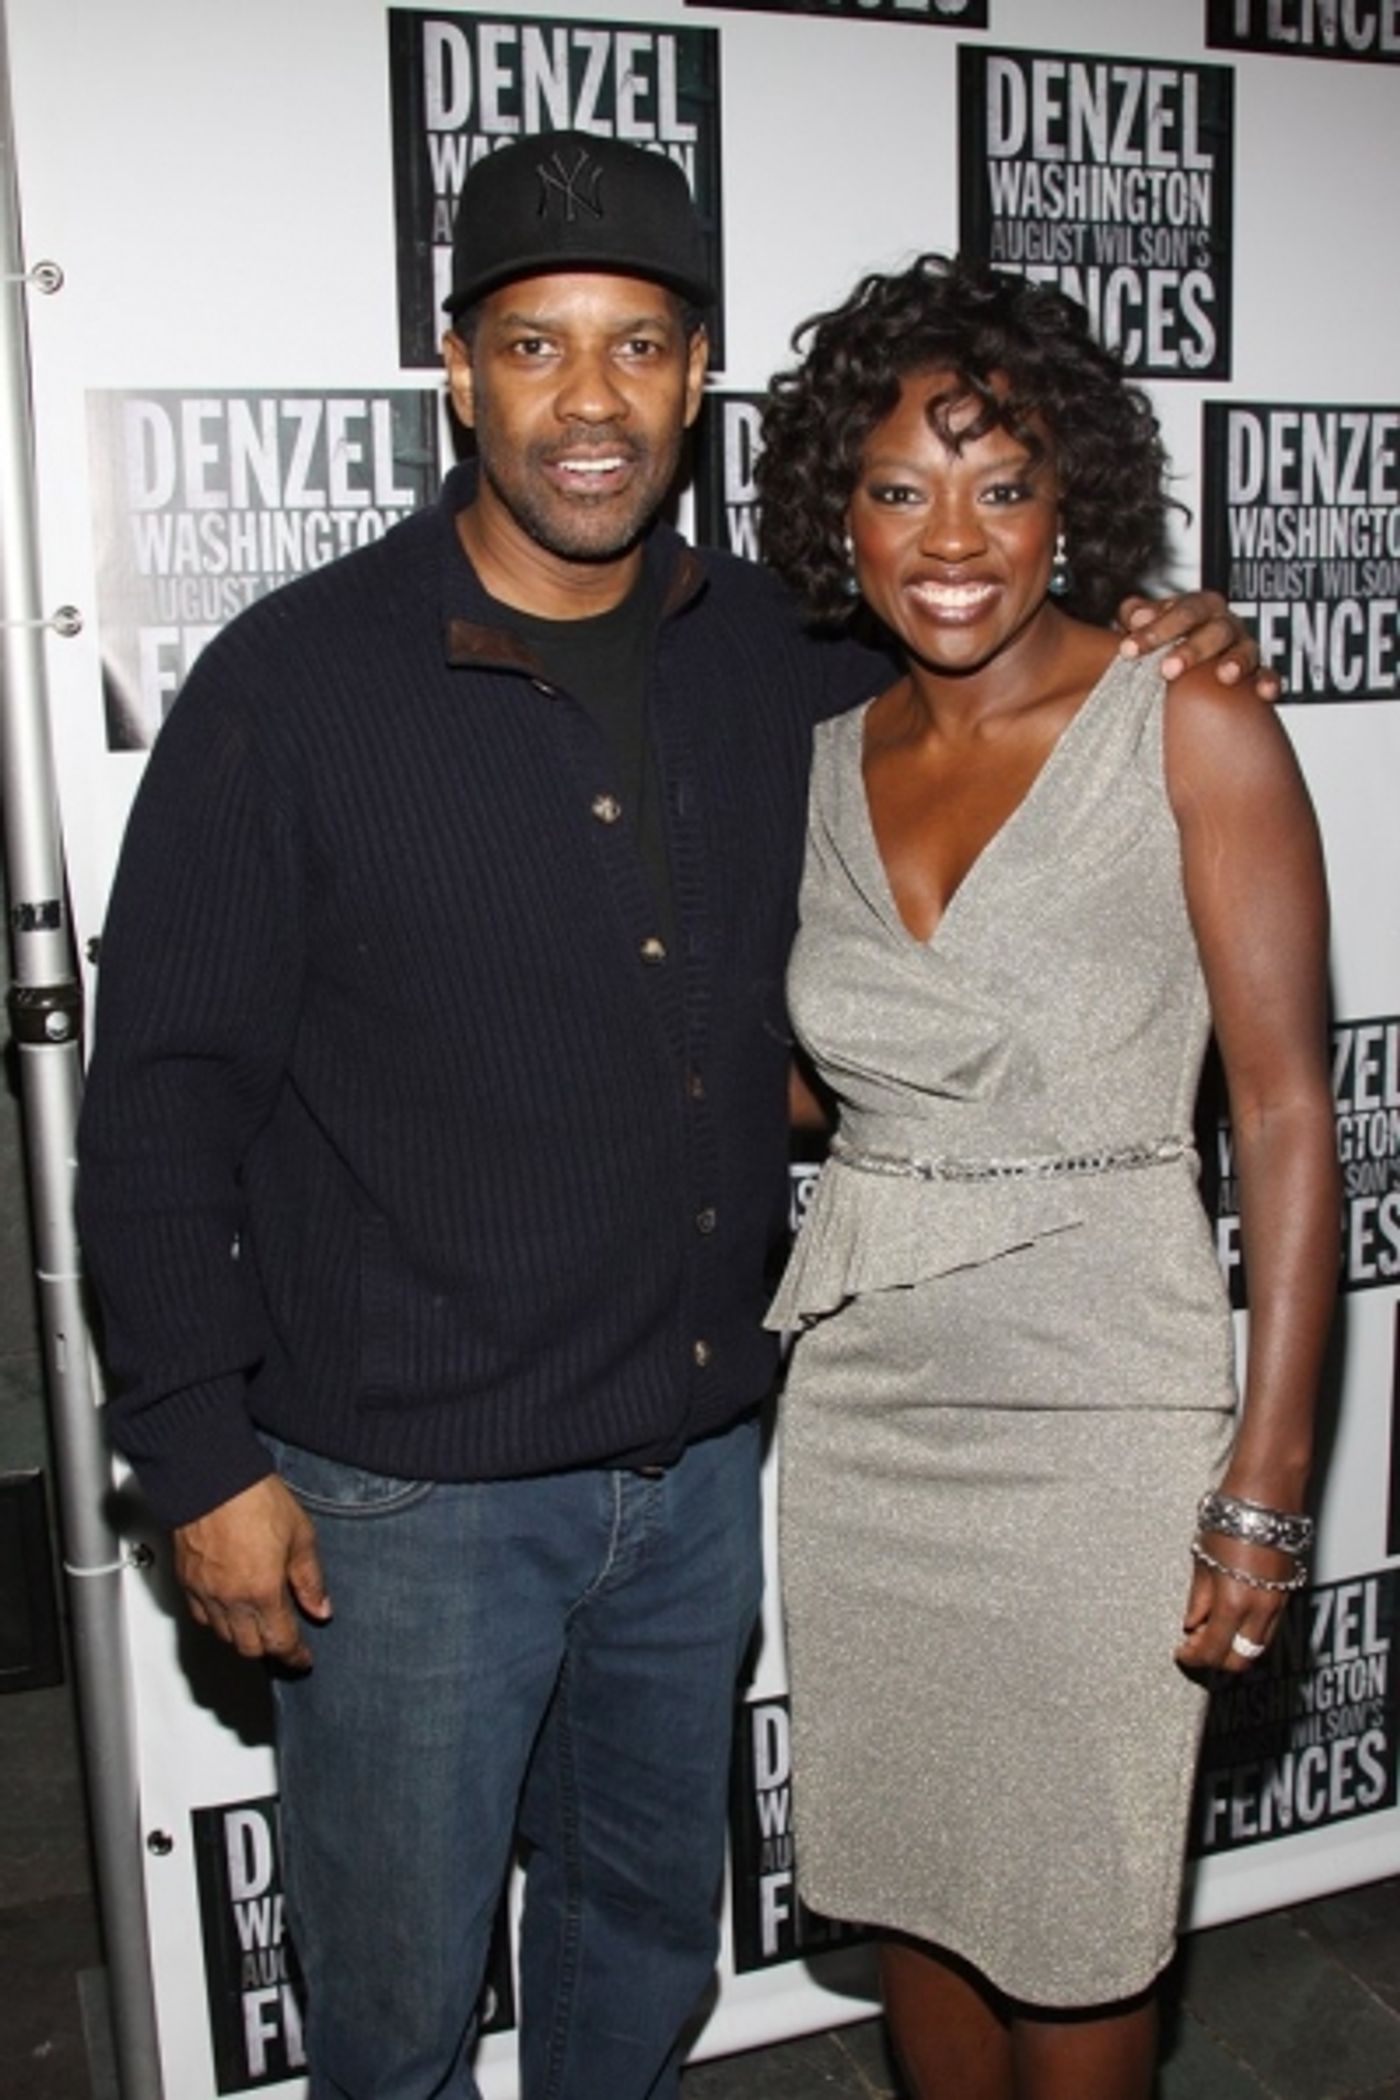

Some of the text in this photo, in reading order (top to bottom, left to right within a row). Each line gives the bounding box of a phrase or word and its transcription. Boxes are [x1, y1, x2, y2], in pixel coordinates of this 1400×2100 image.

[423, 20, 698, 143] DENZEL
[986, 55, 1215, 170] DENZEL
[532, 148, 604, 222] NY
[987, 160, 1211, 227] WASHINGTON
[990, 219, 1212, 269] AUGUST WILSON'S
[990, 262, 1217, 370] NCES
[124, 398, 415, 509] DENZEL
[1228, 410, 1399, 506] DENZE
[127, 508, 415, 576] WASHINGTO
[1228, 506, 1400, 559] WASHINGTO
[1229, 558, 1400, 600] AUGUST WILSON
[1228, 600, 1400, 692] ENCE
[1332, 1022, 1400, 1115] ZEL
[1312, 1578, 1391, 1668] ZEL
[1203, 1729, 1388, 1847] FENCES
